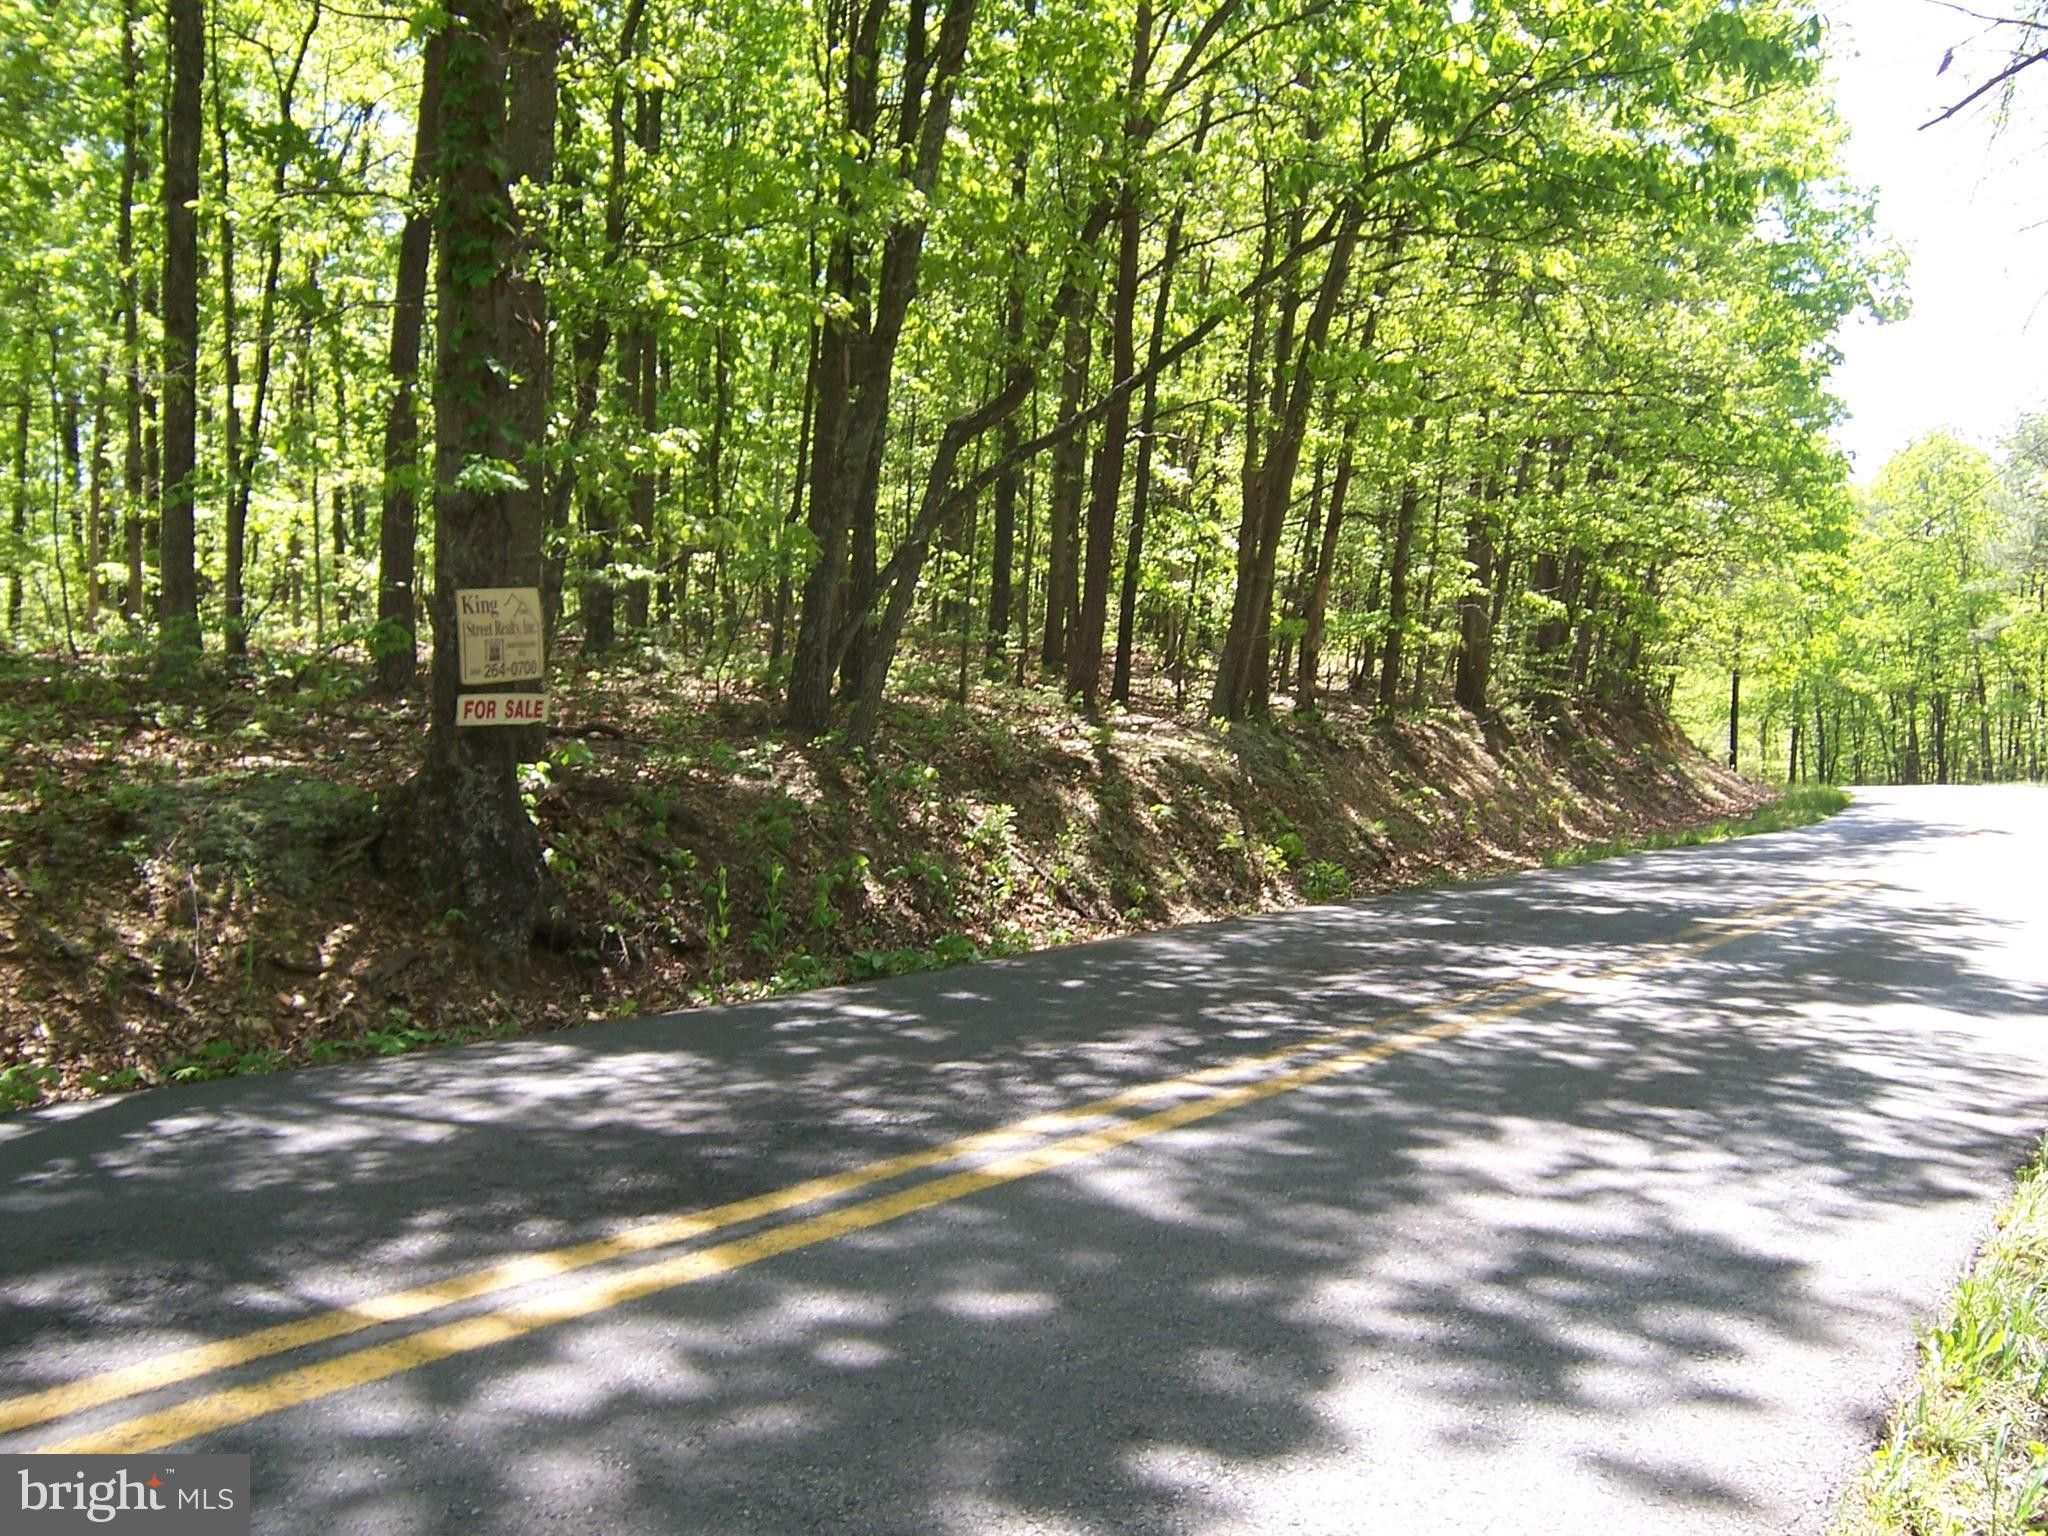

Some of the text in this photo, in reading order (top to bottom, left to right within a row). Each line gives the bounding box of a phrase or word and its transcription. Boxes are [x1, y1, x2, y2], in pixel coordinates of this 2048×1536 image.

[462, 595, 499, 618] King
[466, 622, 493, 637] Street
[484, 660, 537, 679] 264-0700
[463, 699, 545, 719] FOR SALE
